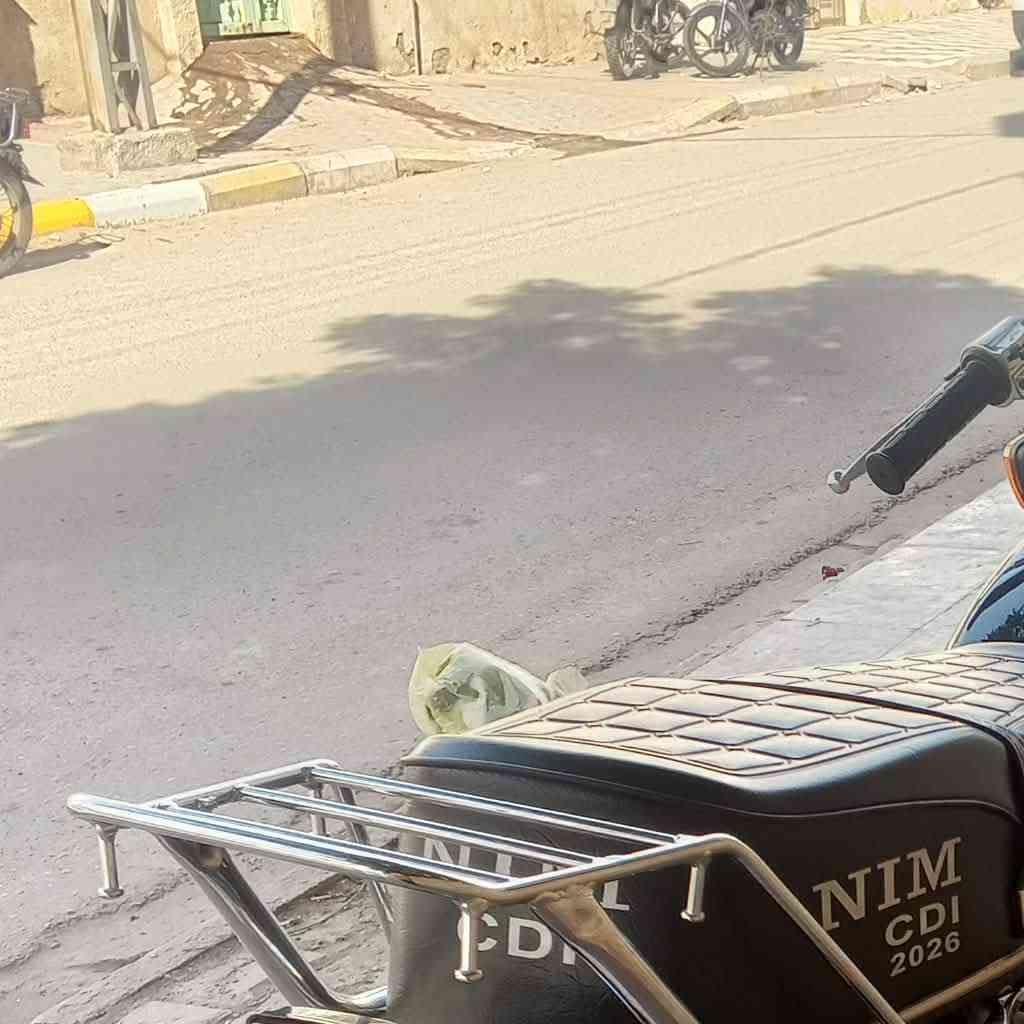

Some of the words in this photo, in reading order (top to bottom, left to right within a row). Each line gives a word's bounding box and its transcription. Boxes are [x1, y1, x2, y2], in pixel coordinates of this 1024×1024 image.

[812, 836, 962, 931] NIM
[885, 895, 960, 946] CDI
[889, 931, 961, 977] 2026
